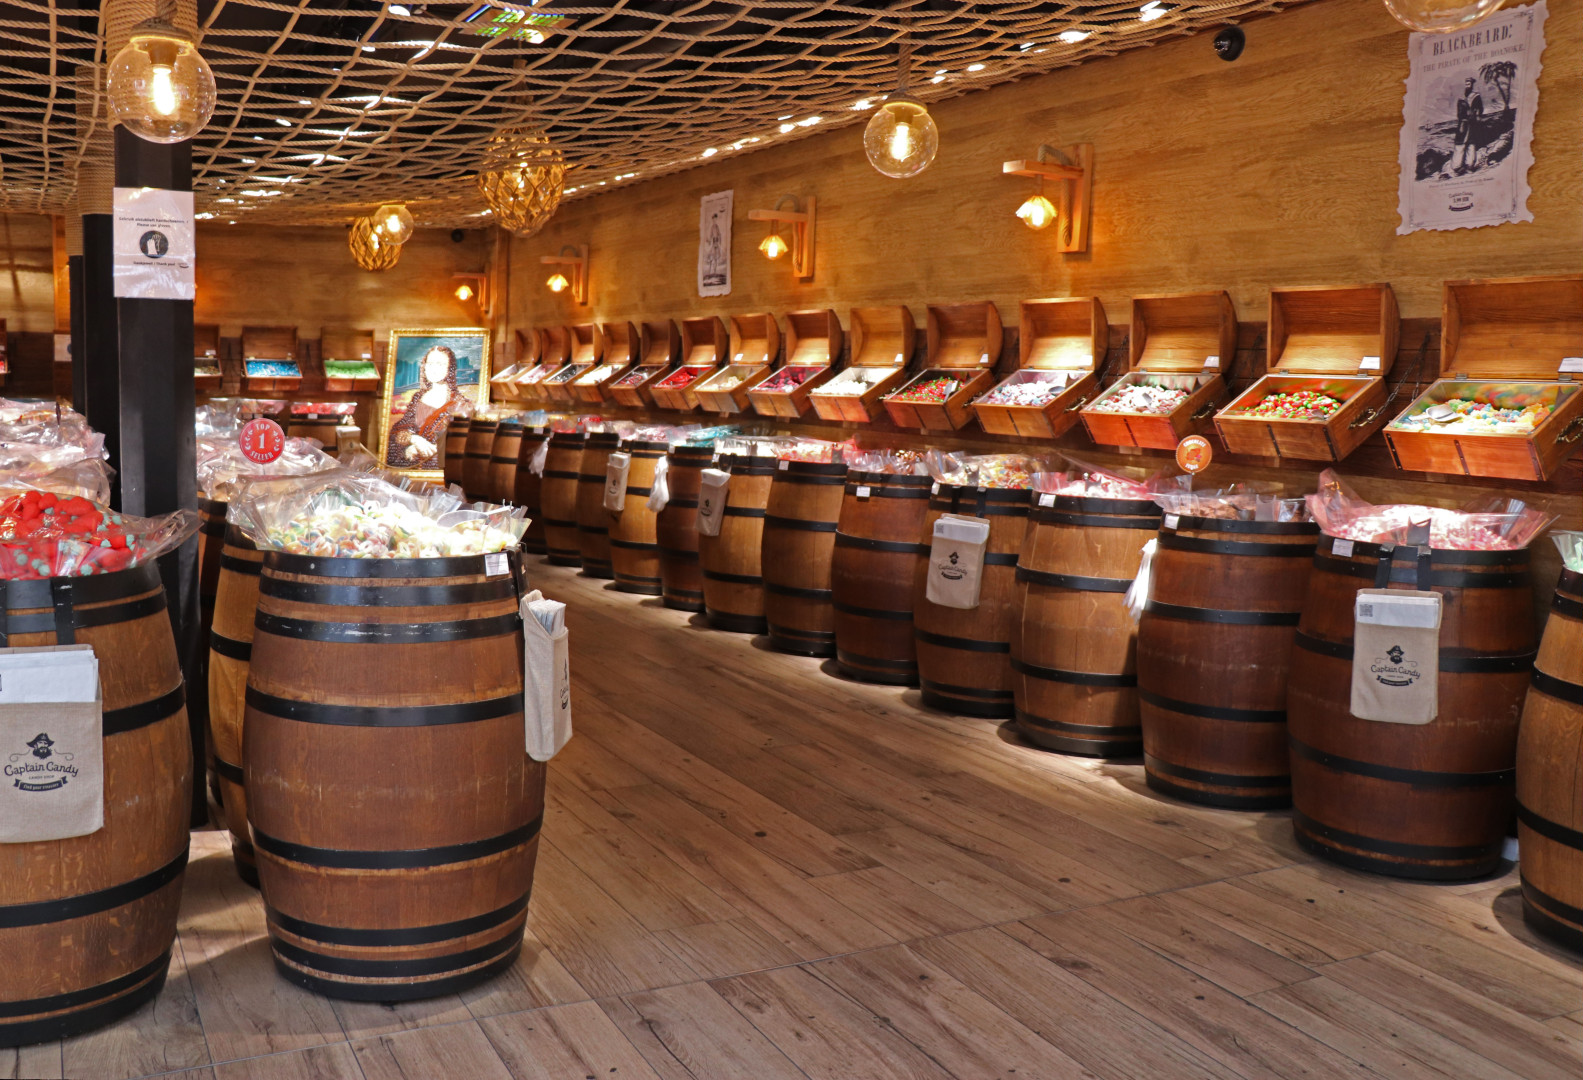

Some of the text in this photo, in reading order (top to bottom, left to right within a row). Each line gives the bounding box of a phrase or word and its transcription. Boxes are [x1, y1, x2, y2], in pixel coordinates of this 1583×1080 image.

[1434, 24, 1512, 56] BLACKBEARD:
[1423, 63, 1435, 72] THE
[1438, 58, 1460, 70] PIRATE
[1462, 56, 1470, 64] OF
[1474, 51, 1488, 61] THE
[259, 433, 265, 449] 1
[250, 450, 274, 460] SELLER
[1371, 665, 1420, 679] Captain Candy
[4, 761, 79, 778] Captain Candy
